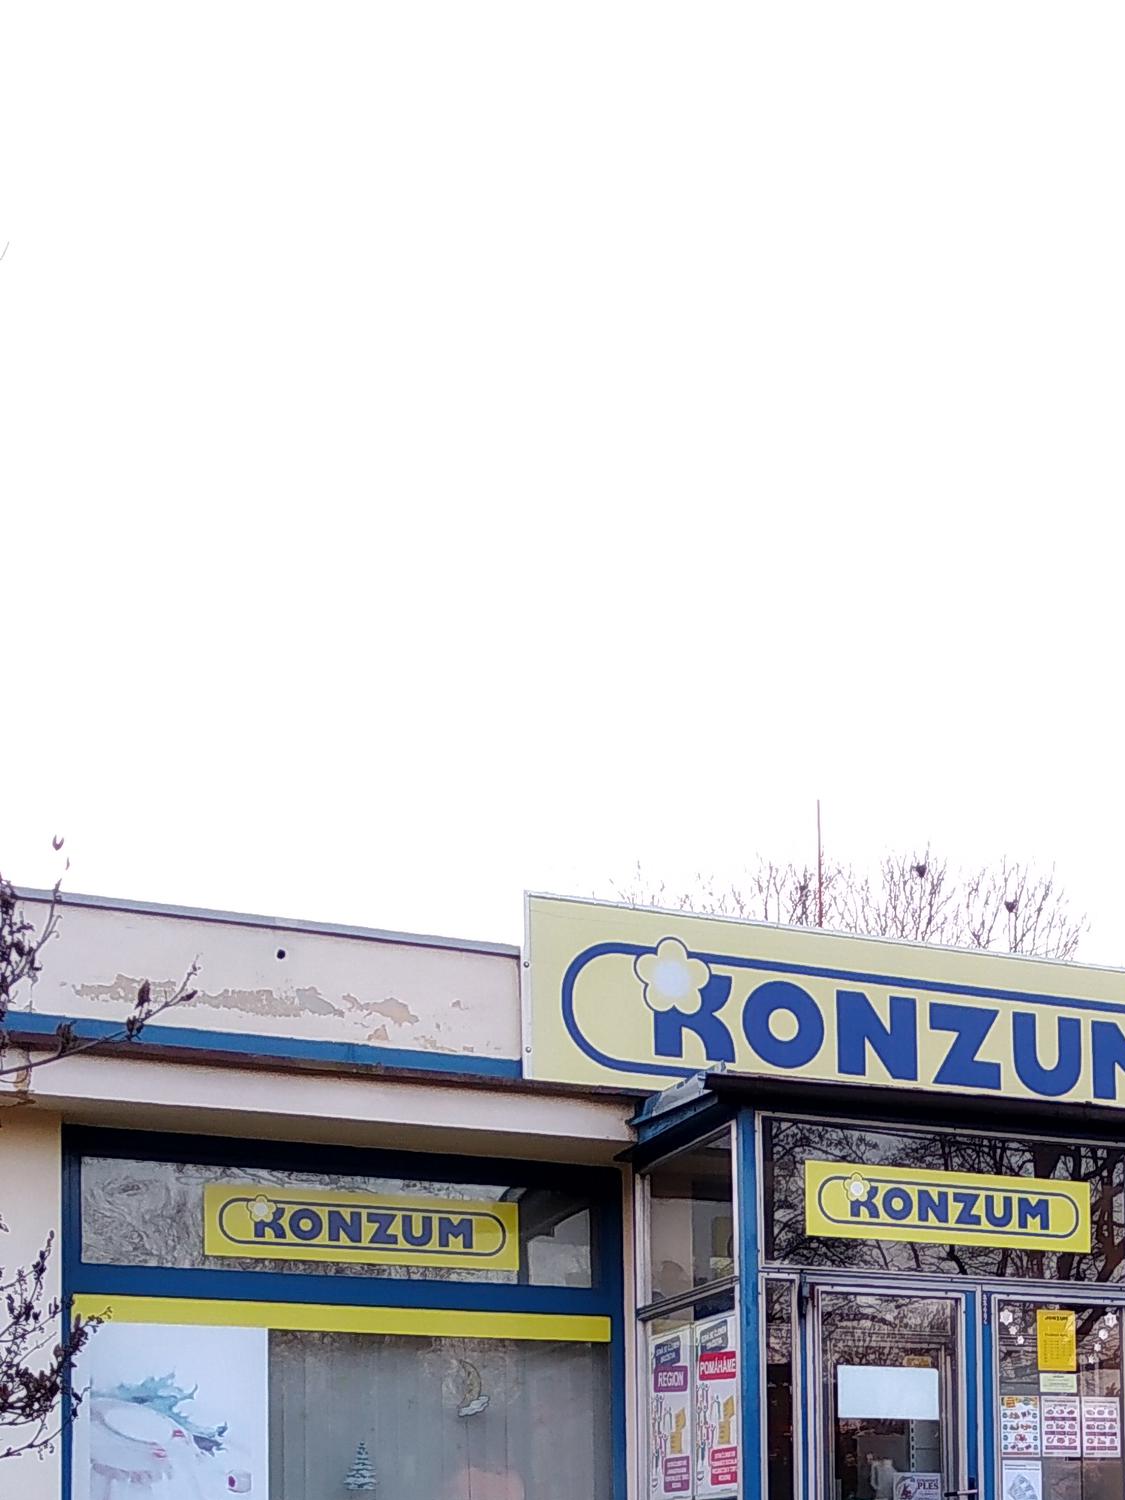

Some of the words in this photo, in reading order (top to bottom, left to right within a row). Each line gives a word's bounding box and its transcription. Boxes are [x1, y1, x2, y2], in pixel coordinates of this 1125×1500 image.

[849, 1185, 1050, 1231] KONZUM
[253, 1206, 474, 1250] KONZUM
[699, 1357, 737, 1376] POMÁHÁME
[657, 1371, 684, 1387] REGION
[917, 1481, 939, 1490] PLES
